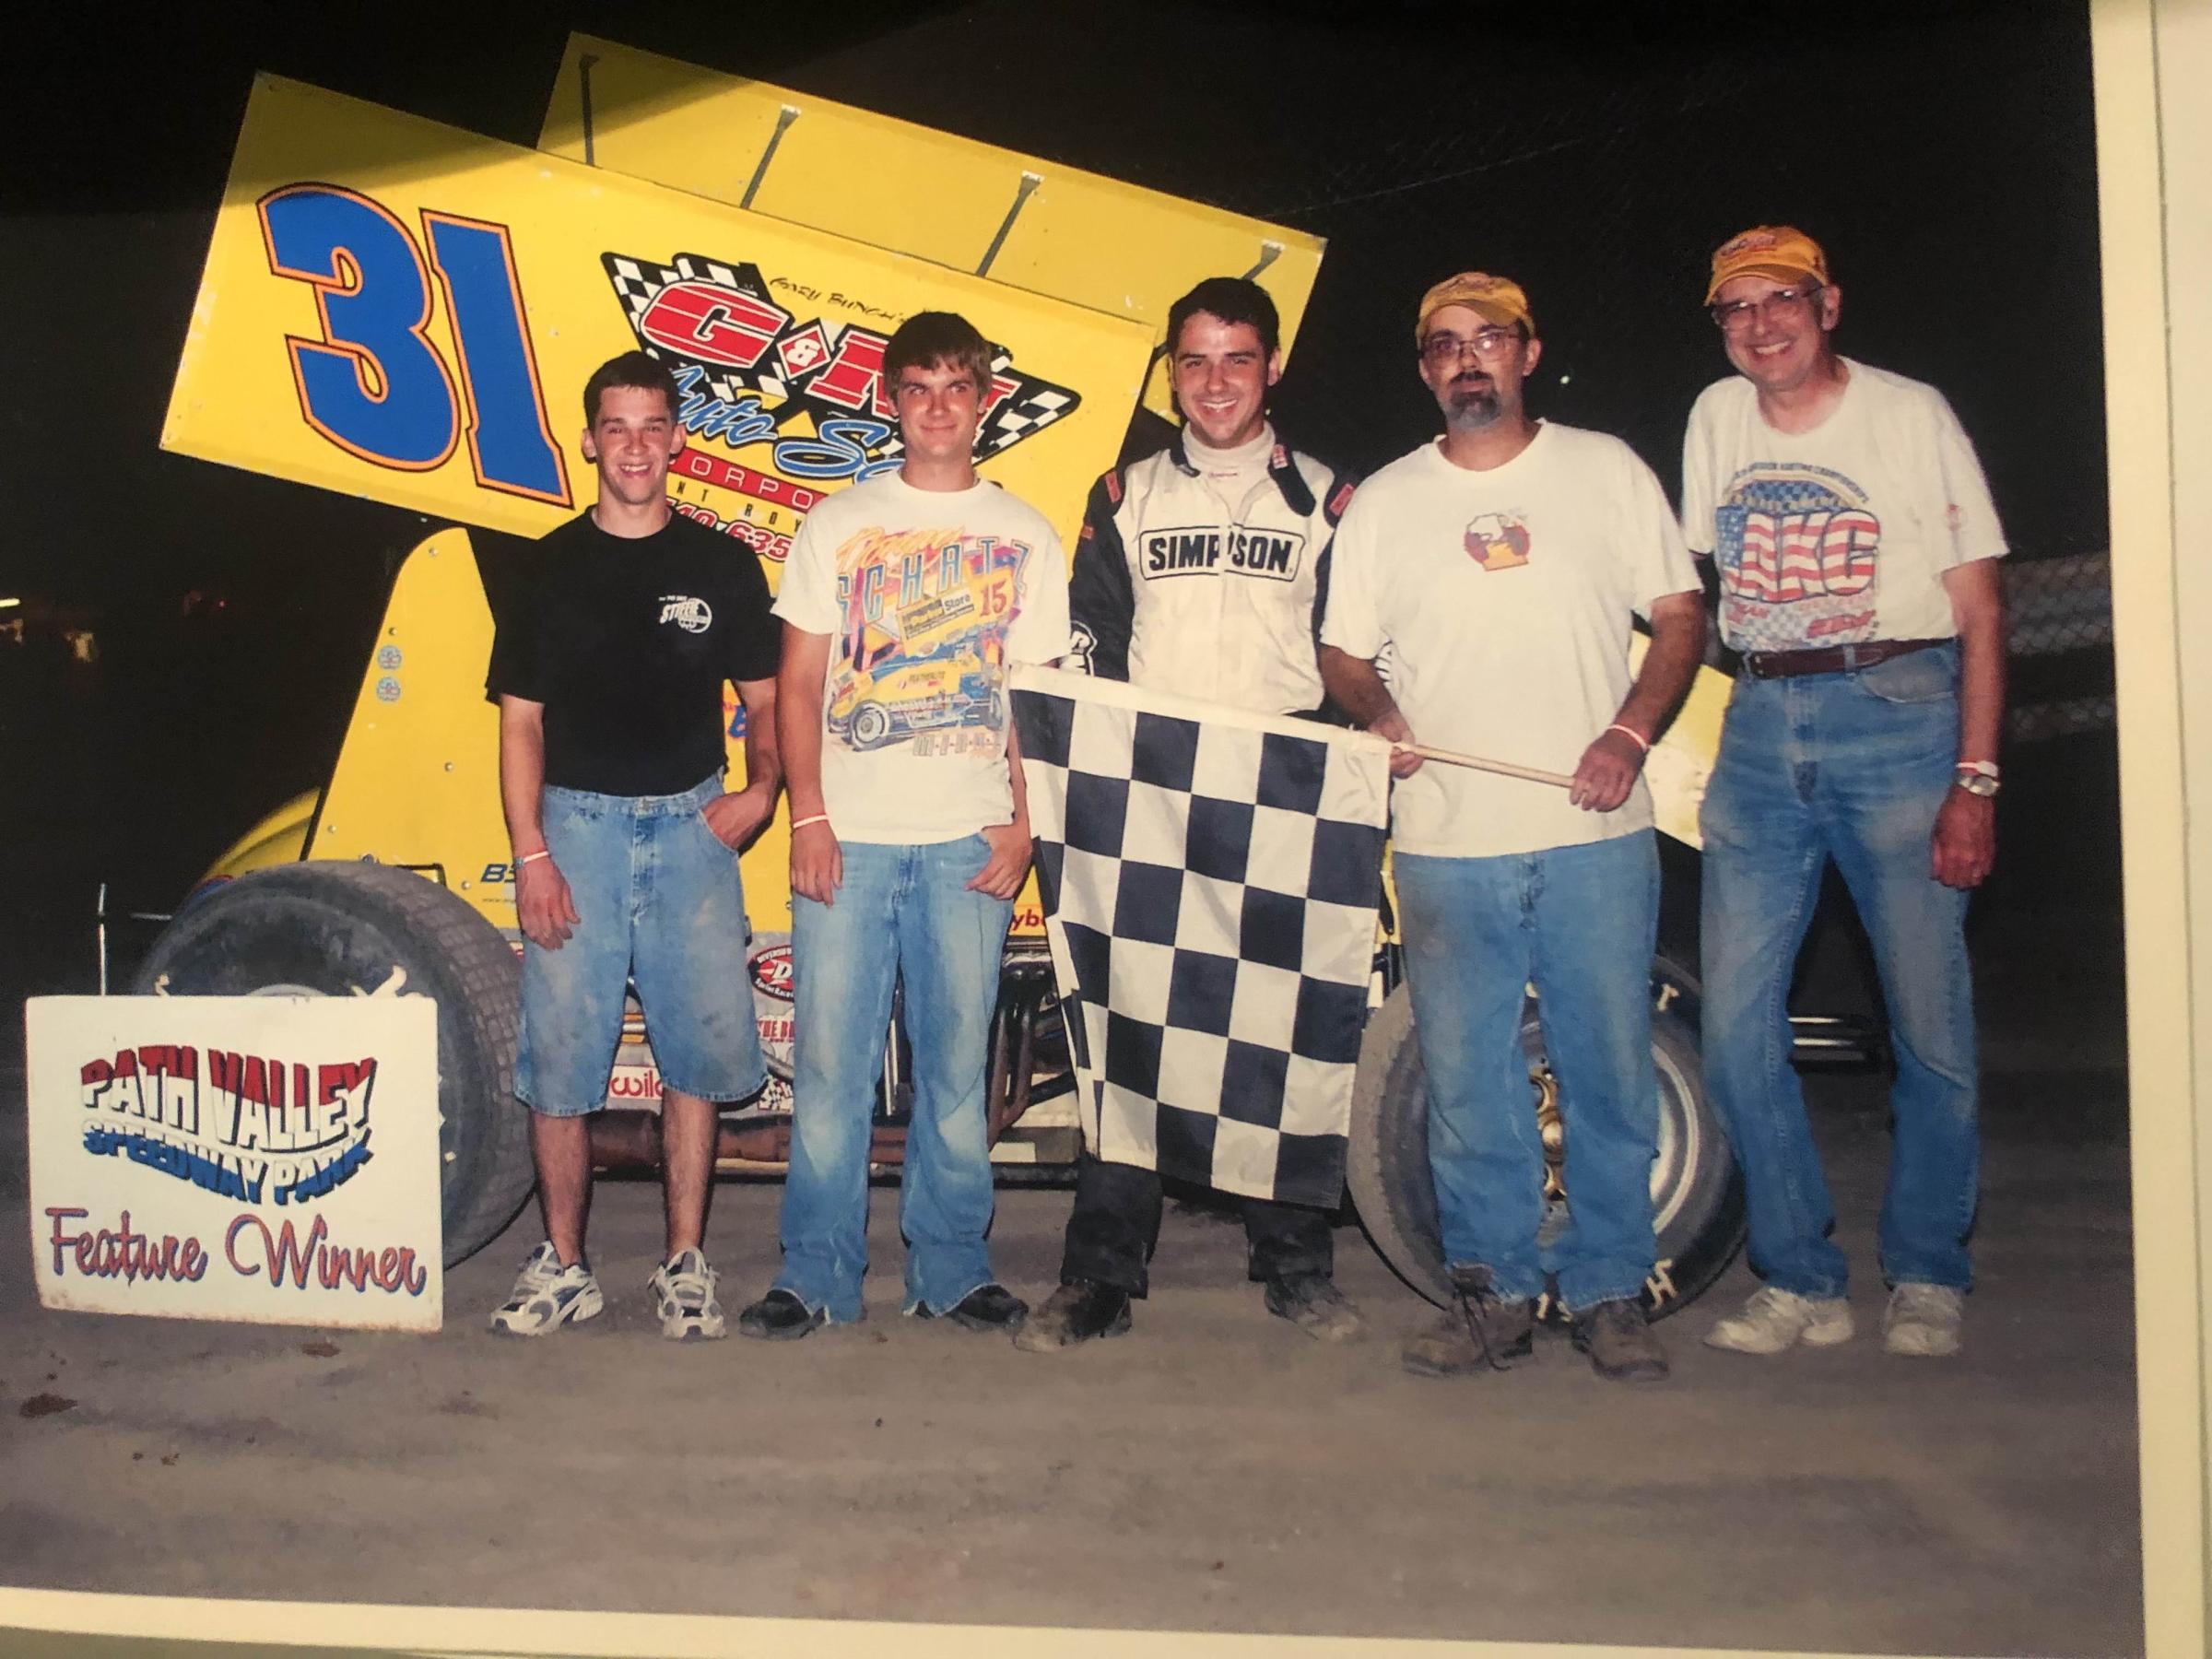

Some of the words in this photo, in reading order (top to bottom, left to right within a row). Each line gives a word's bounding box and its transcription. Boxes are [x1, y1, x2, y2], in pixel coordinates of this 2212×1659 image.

[256, 182, 575, 510] 31
[1148, 531, 1293, 574] SIMPSON
[980, 579, 1008, 617] 15
[81, 1045, 199, 1135] PATH
[208, 1048, 378, 1153] VALLEY
[83, 1118, 268, 1205] SPEEDWAY
[273, 1126, 373, 1206] PARK
[45, 1207, 208, 1285] Feature
[225, 1213, 426, 1296] Winner
